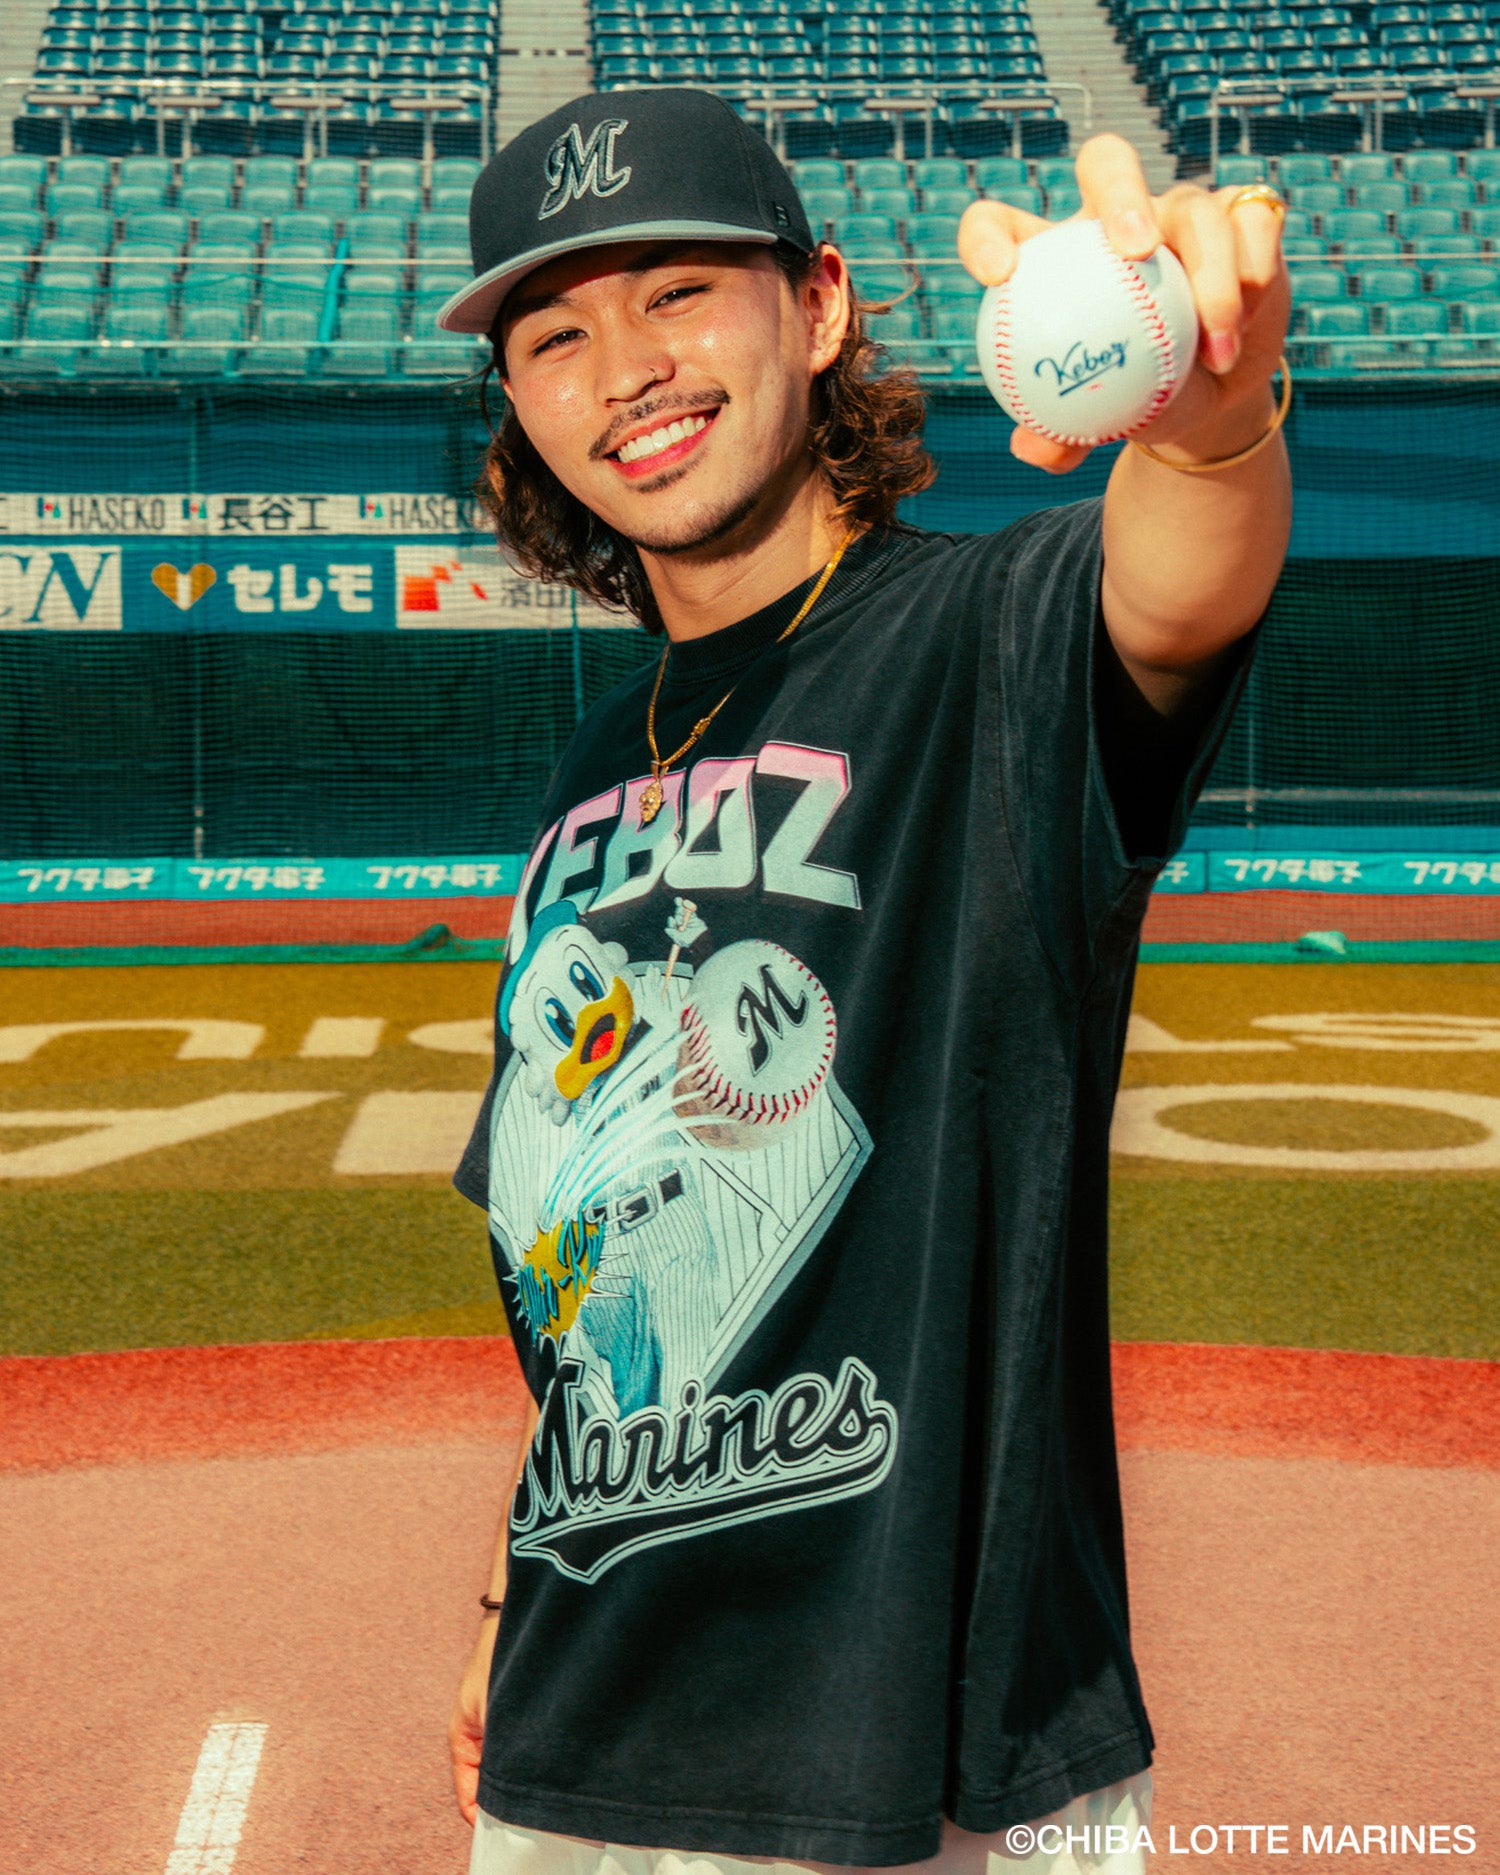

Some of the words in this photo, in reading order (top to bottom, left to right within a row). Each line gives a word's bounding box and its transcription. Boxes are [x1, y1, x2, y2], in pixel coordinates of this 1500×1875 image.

[538, 118, 631, 221] M
[69, 496, 165, 531] HASEKO
[222, 496, 328, 531] 長谷工
[227, 563, 374, 613] セレモ
[511, 1355, 899, 1533] Marines
